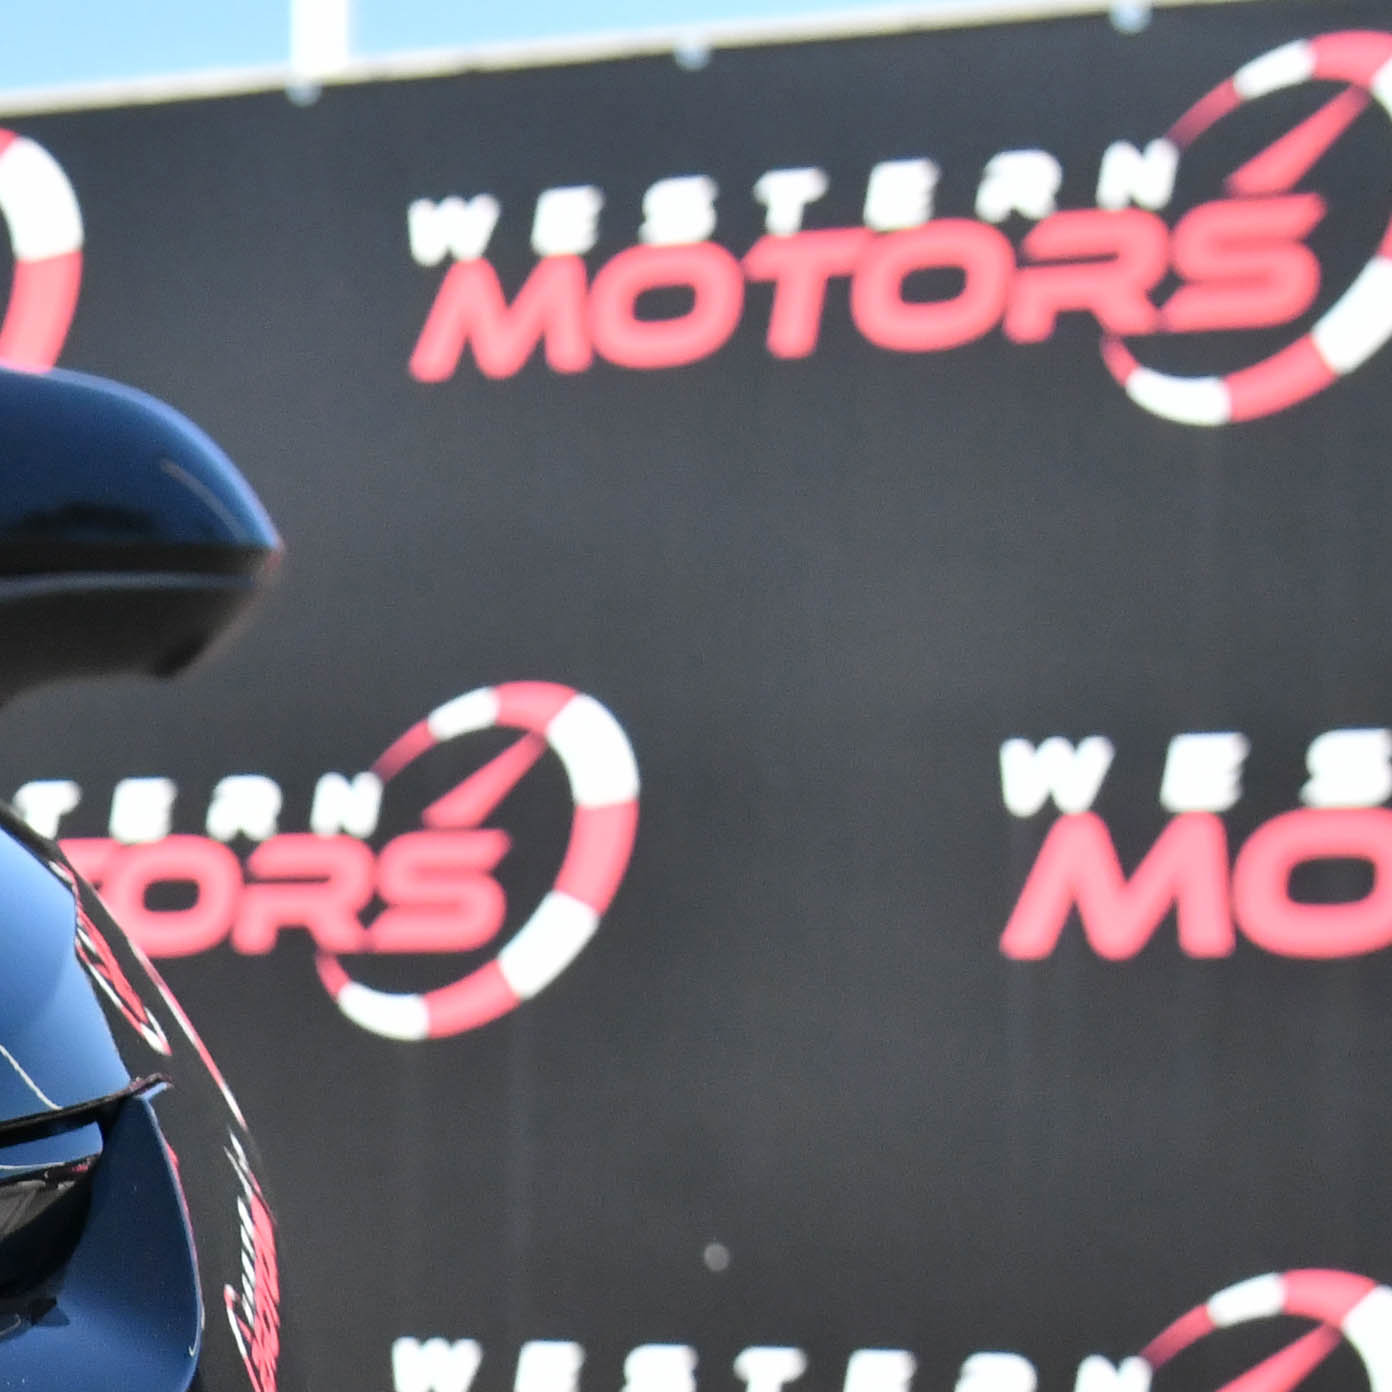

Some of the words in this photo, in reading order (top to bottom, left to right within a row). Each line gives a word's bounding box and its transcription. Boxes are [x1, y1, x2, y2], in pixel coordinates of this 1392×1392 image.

[407, 138, 1180, 266] WESTERN
[408, 193, 1324, 384] MOTORS
[999, 728, 1392, 818] WES
[998, 808, 1392, 961] MO
